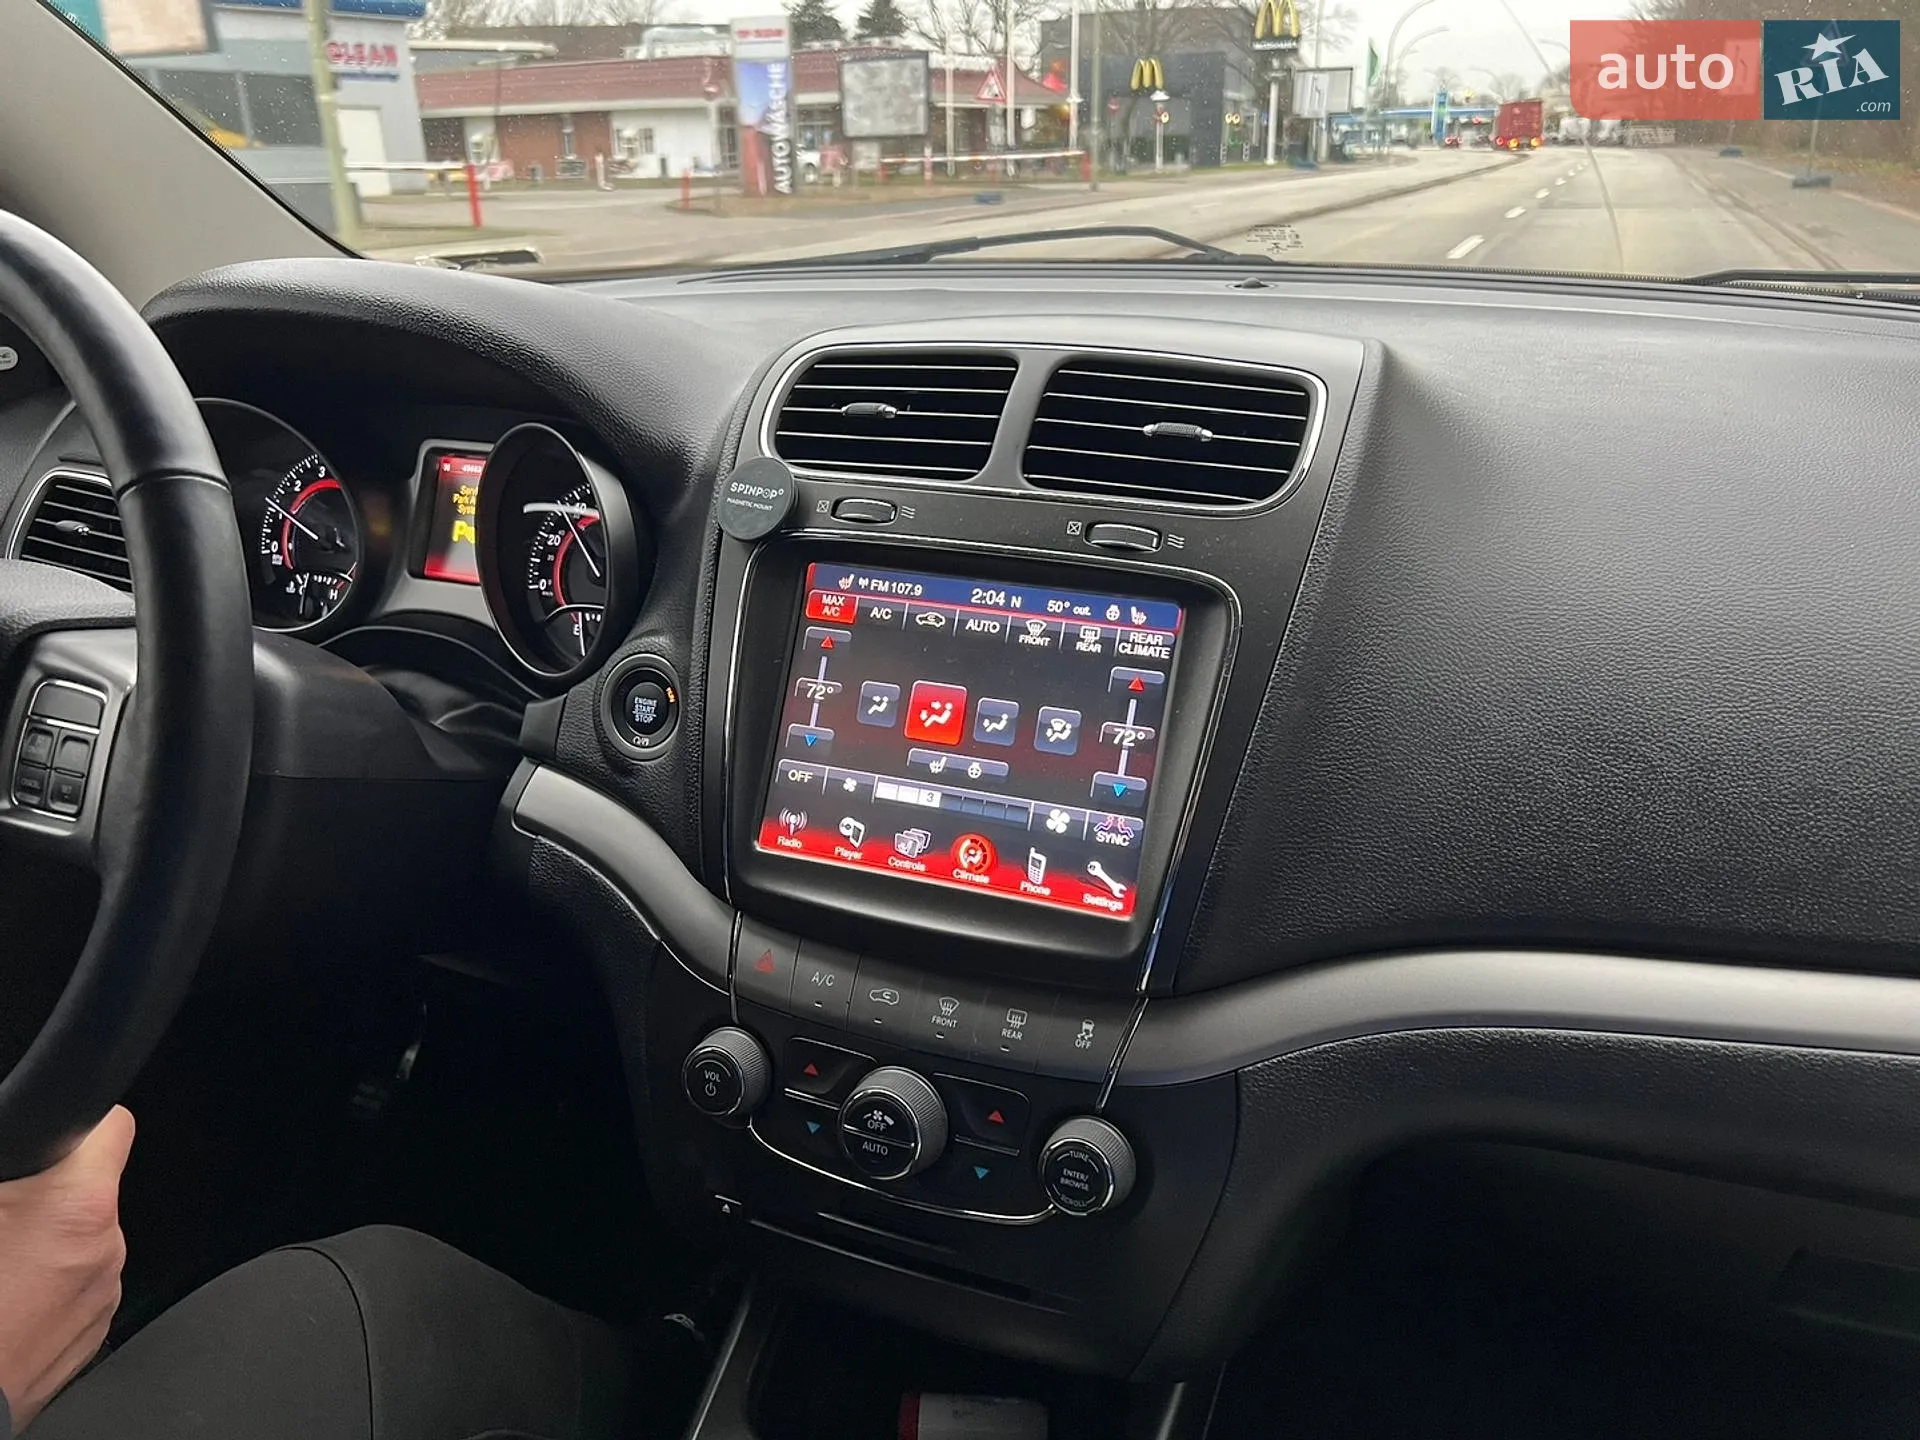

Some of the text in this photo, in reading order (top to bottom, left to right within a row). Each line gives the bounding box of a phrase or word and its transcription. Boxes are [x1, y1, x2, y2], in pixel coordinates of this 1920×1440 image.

[326, 42, 398, 67] CLEAN
[318, 466, 326, 478] 3
[294, 480, 302, 492] 2
[753, 502, 774, 511] MOUNT
[270, 541, 279, 552] 0
[547, 534, 561, 546] 20
[539, 579, 547, 590] 0
[870, 580, 923, 596] FM 107.9
[330, 589, 339, 600] H
[821, 594, 846, 607] MAX
[970, 588, 1022, 608] 2:04 N
[821, 606, 841, 617] A/C
[870, 606, 893, 620] A/C
[965, 618, 1000, 634] AUTO
[1018, 634, 1051, 648] FRONT
[1129, 632, 1164, 646] REAR
[1075, 641, 1102, 653] REAR
[1118, 642, 1171, 660] CLIMATE
[634, 696, 657, 707] ENGINE
[634, 704, 655, 715] START
[634, 715, 654, 724] STOP
[788, 769, 813, 783] OFF
[926, 792, 935, 803] 3
[777, 835, 803, 849] Radio
[1095, 831, 1130, 847] SYNC
[834, 846, 864, 861] Player
[887, 855, 926, 872] Controls
[952, 868, 990, 884] Climate
[1020, 881, 1051, 896] Phone
[1082, 893, 1124, 912] Settings
[811, 971, 835, 987] A/C
[931, 1014, 957, 1029] FRONT
[1001, 1027, 1023, 1041] REAR
[1074, 1038, 1093, 1050] OFF
[704, 1069, 721, 1083] VOL
[866, 1119, 888, 1132] OFF
[862, 1140, 889, 1156] AUTO
[1069, 1150, 1090, 1162] TUNE
[1062, 1168, 1089, 1182] ENTER/
[1060, 1177, 1089, 1191] BROWSE
